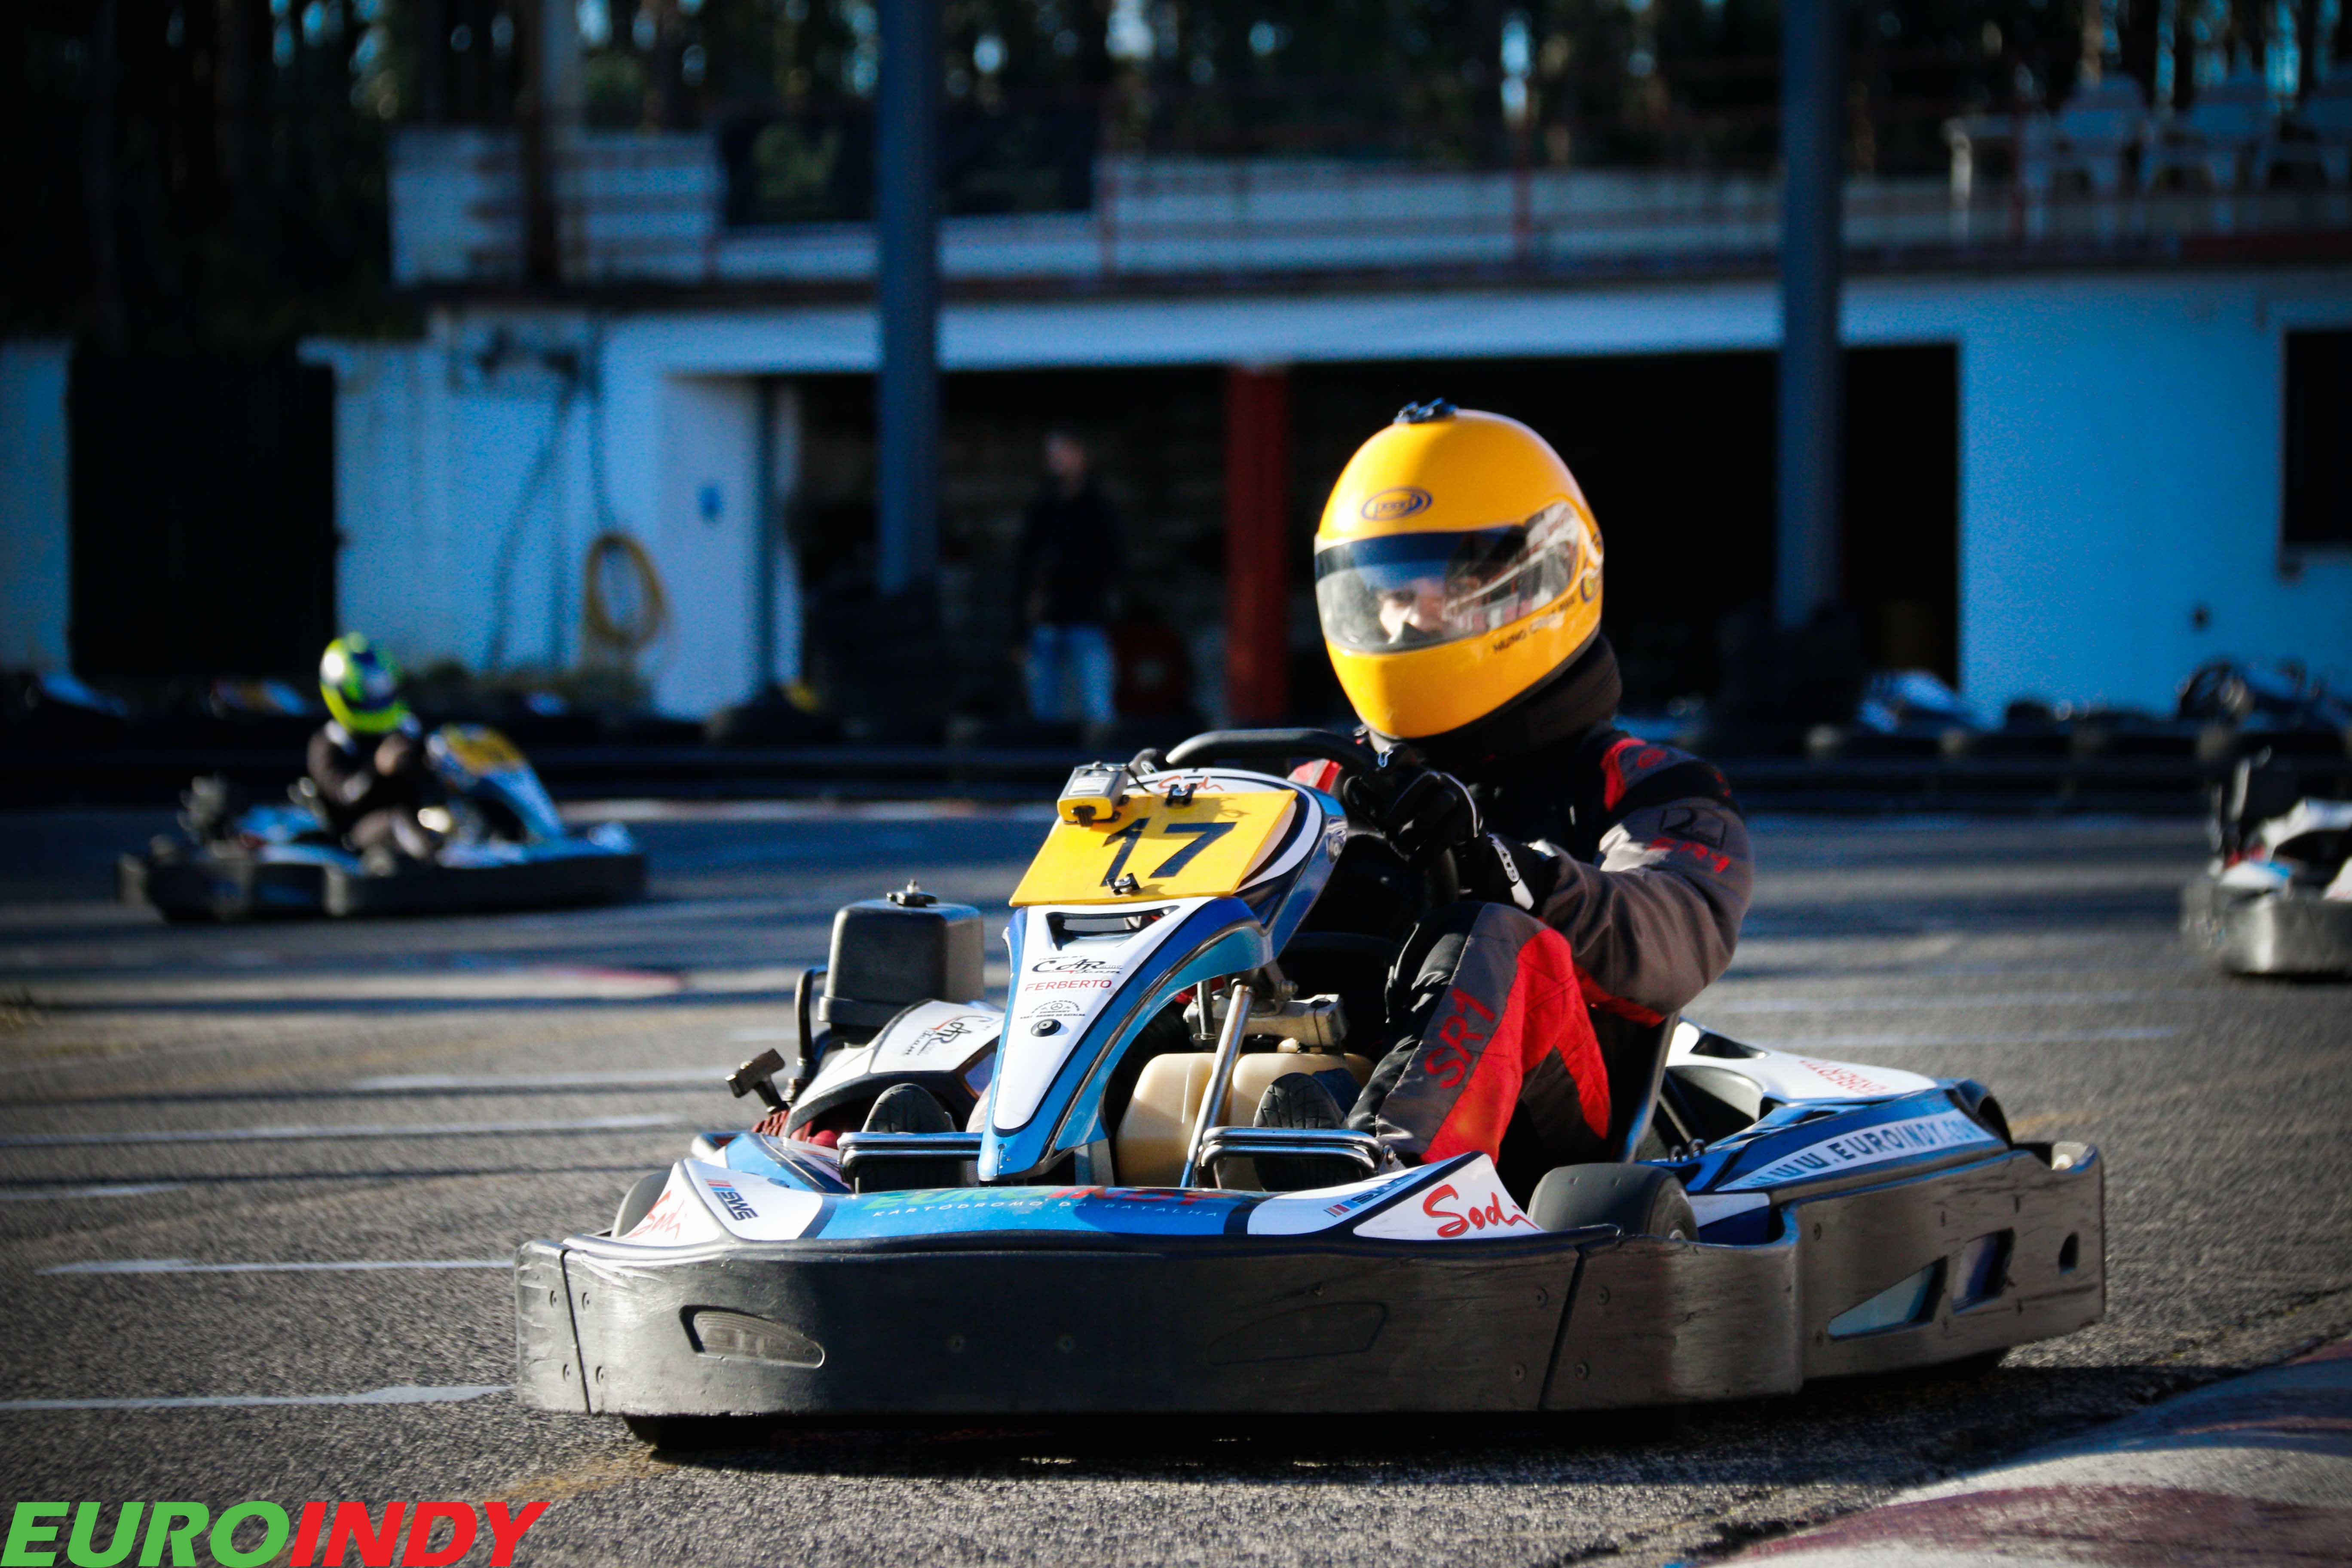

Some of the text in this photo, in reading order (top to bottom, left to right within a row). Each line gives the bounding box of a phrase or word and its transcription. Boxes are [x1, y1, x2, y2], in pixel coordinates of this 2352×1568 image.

[1099, 818, 1238, 887] 17
[1025, 980, 1112, 992] FERBERTO
[1424, 987, 1495, 1088] SR1
[1105, 1203, 1218, 1216] BATALHA
[1422, 1184, 1540, 1238] Sodi
